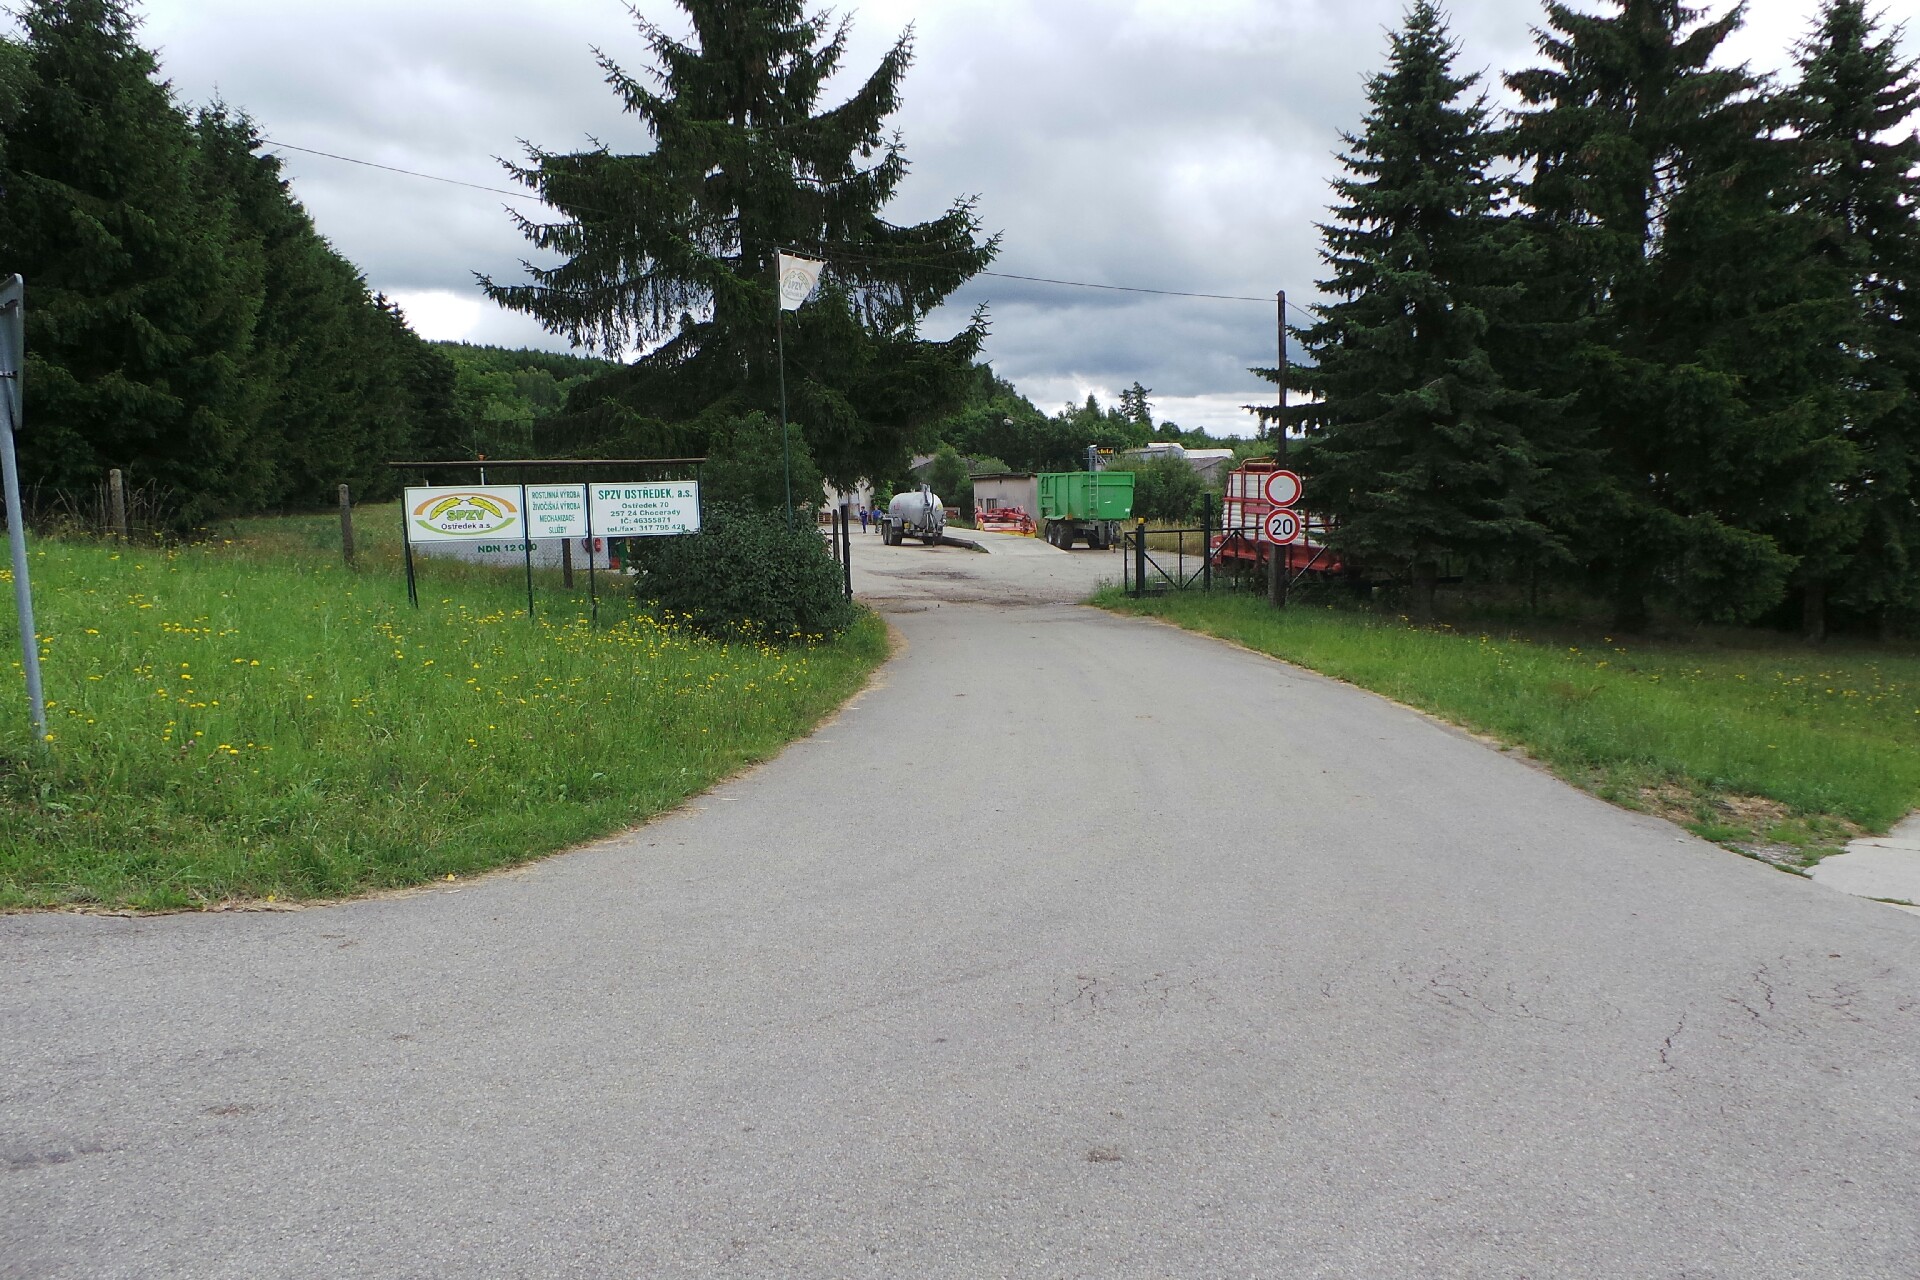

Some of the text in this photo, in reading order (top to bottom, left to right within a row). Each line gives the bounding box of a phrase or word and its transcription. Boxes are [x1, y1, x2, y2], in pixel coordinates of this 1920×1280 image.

[560, 489, 581, 499] VÝROBA
[598, 489, 621, 500] SPZV
[677, 489, 693, 498] a.s.
[560, 501, 581, 510] VÝROBA
[446, 509, 486, 521] SPZV
[539, 514, 576, 522] MECHANIZACE
[441, 522, 477, 530] Ostředek
[548, 524, 567, 534] SLUŽBY
[1272, 519, 1293, 536] 20
[477, 543, 537, 553] NDN 12 00
